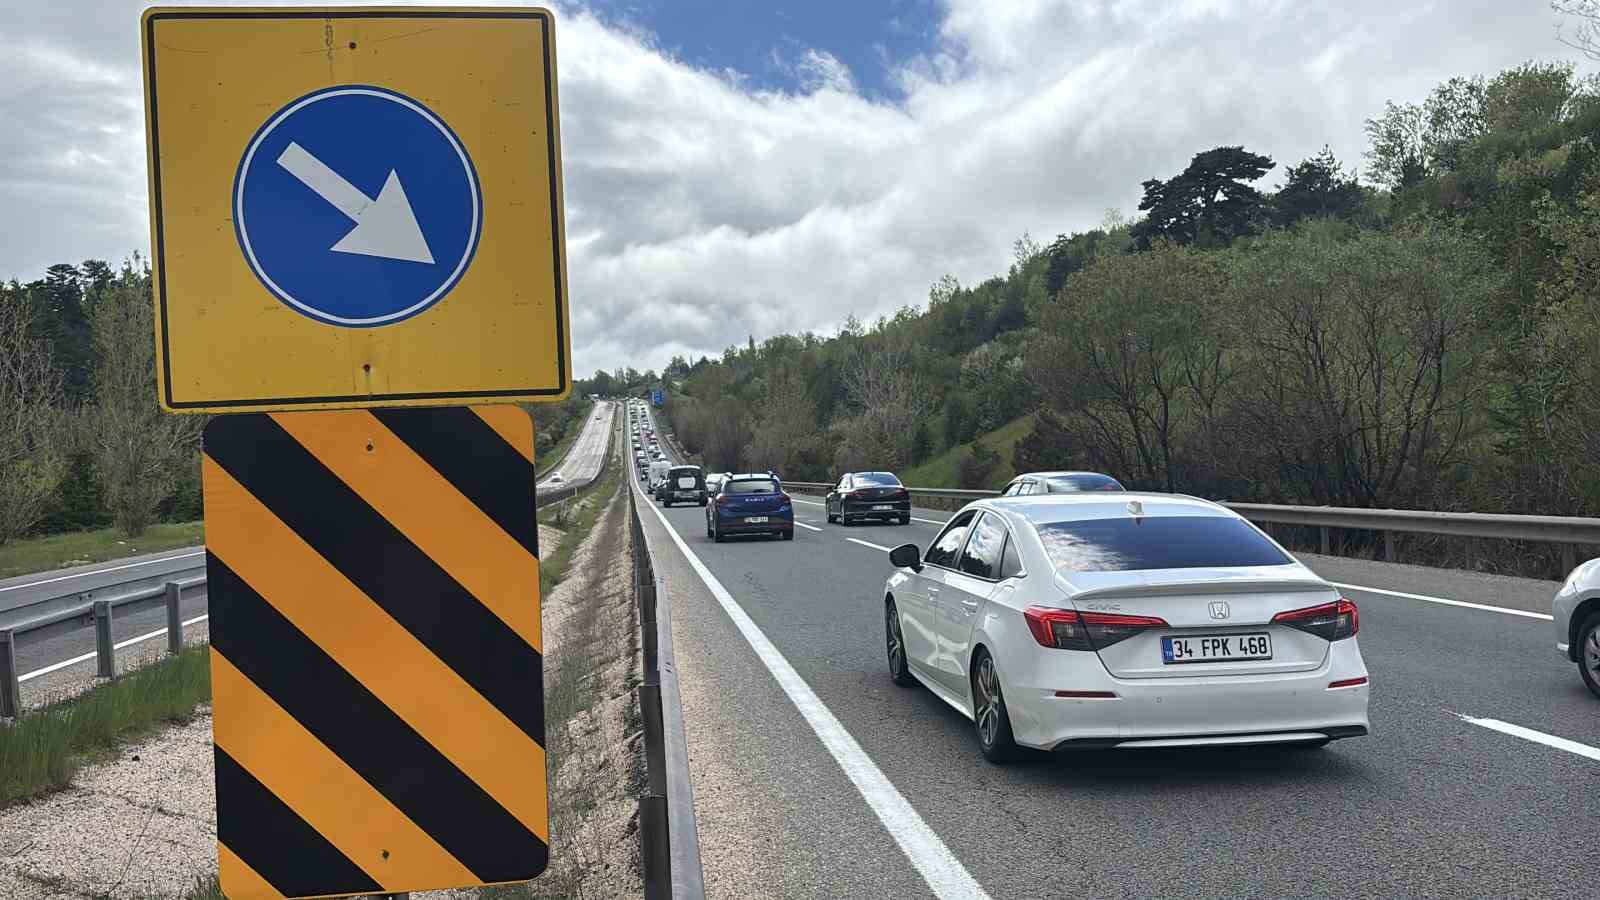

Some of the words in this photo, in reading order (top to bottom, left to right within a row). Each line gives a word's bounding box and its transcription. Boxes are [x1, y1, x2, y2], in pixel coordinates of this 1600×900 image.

[1174, 640, 1193, 658] 34
[1201, 638, 1232, 657] FPK
[1239, 636, 1268, 655] 468
